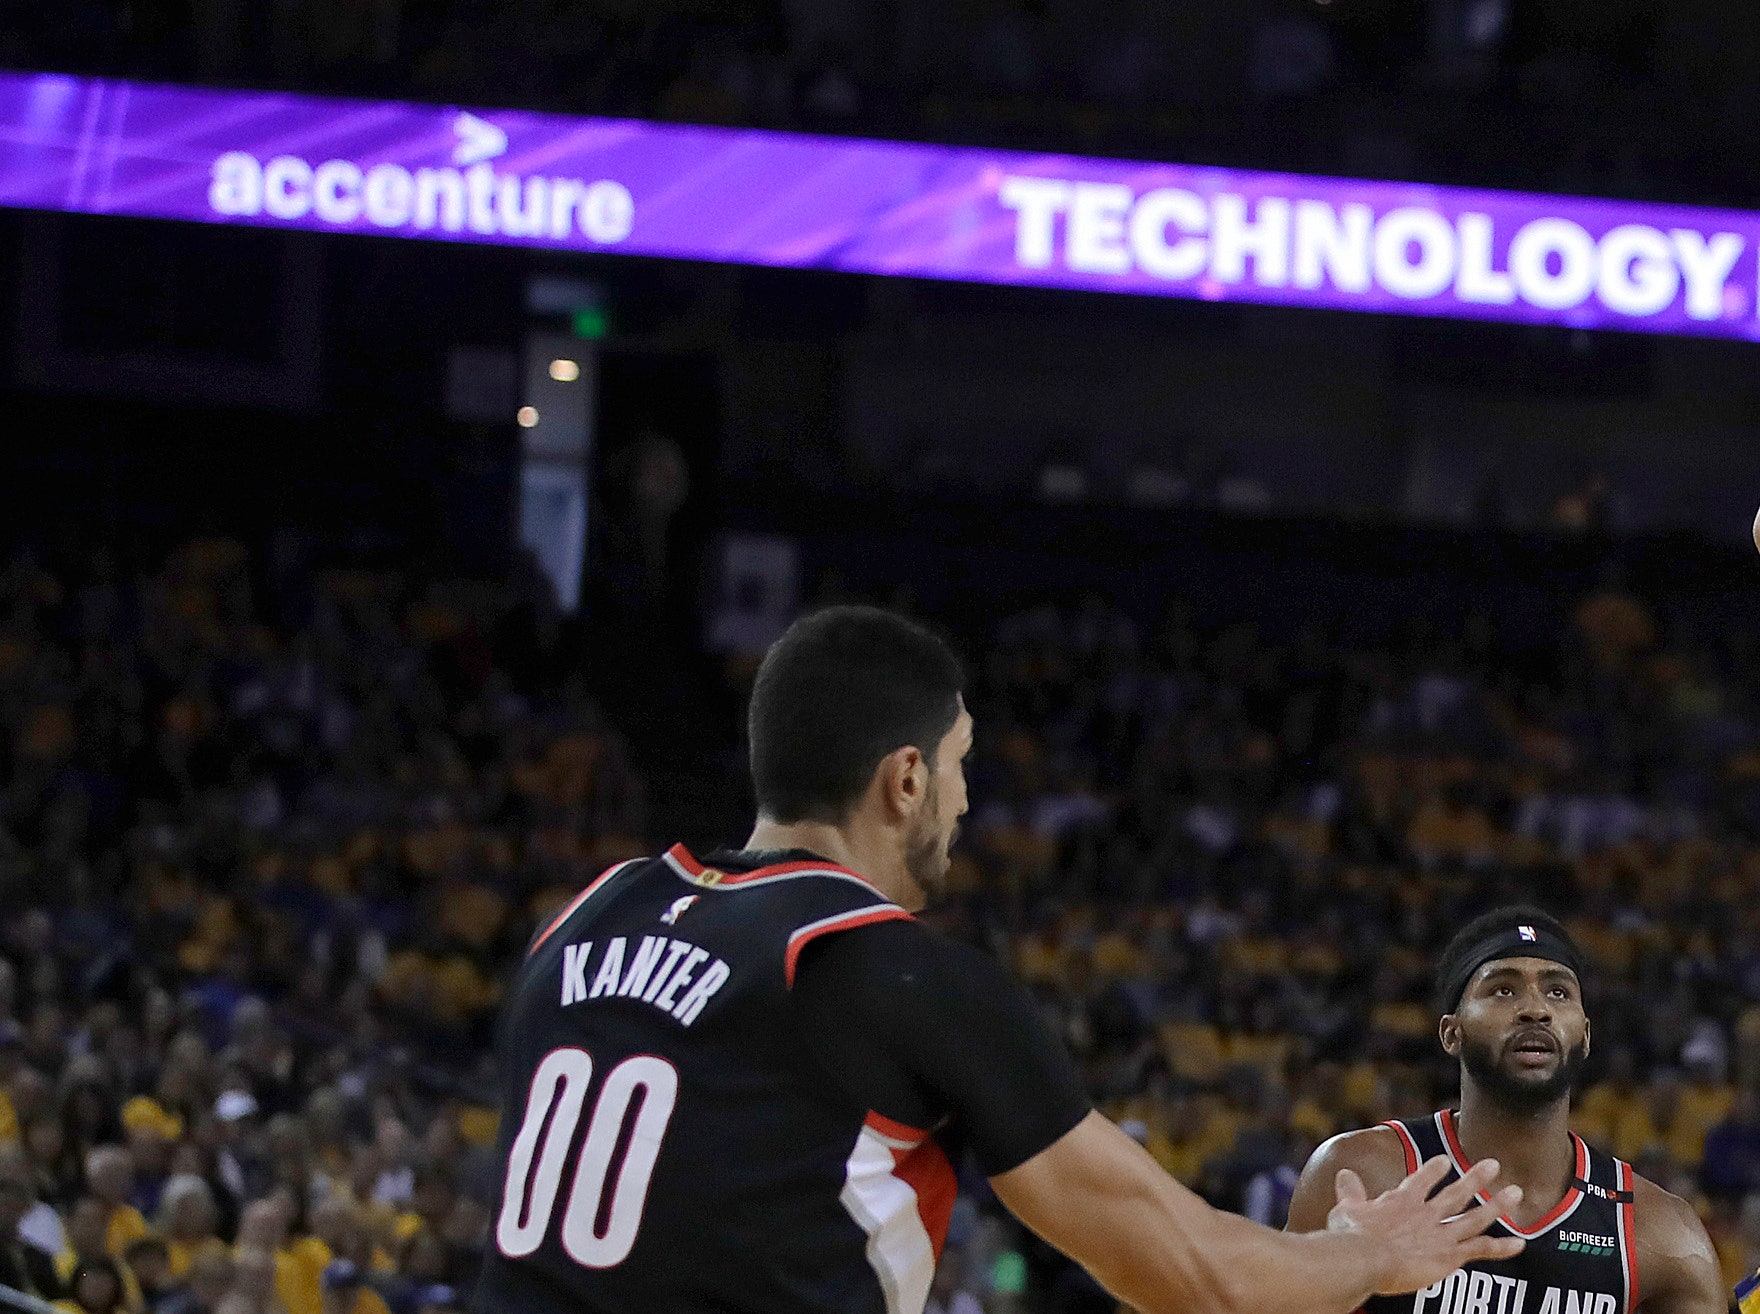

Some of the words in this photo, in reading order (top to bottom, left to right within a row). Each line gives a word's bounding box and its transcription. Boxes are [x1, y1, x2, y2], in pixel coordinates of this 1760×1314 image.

[210, 150, 635, 244] accenture
[998, 174, 1745, 321] TECHNOLOGY
[561, 935, 731, 1027] KANTER
[497, 1046, 679, 1269] 00
